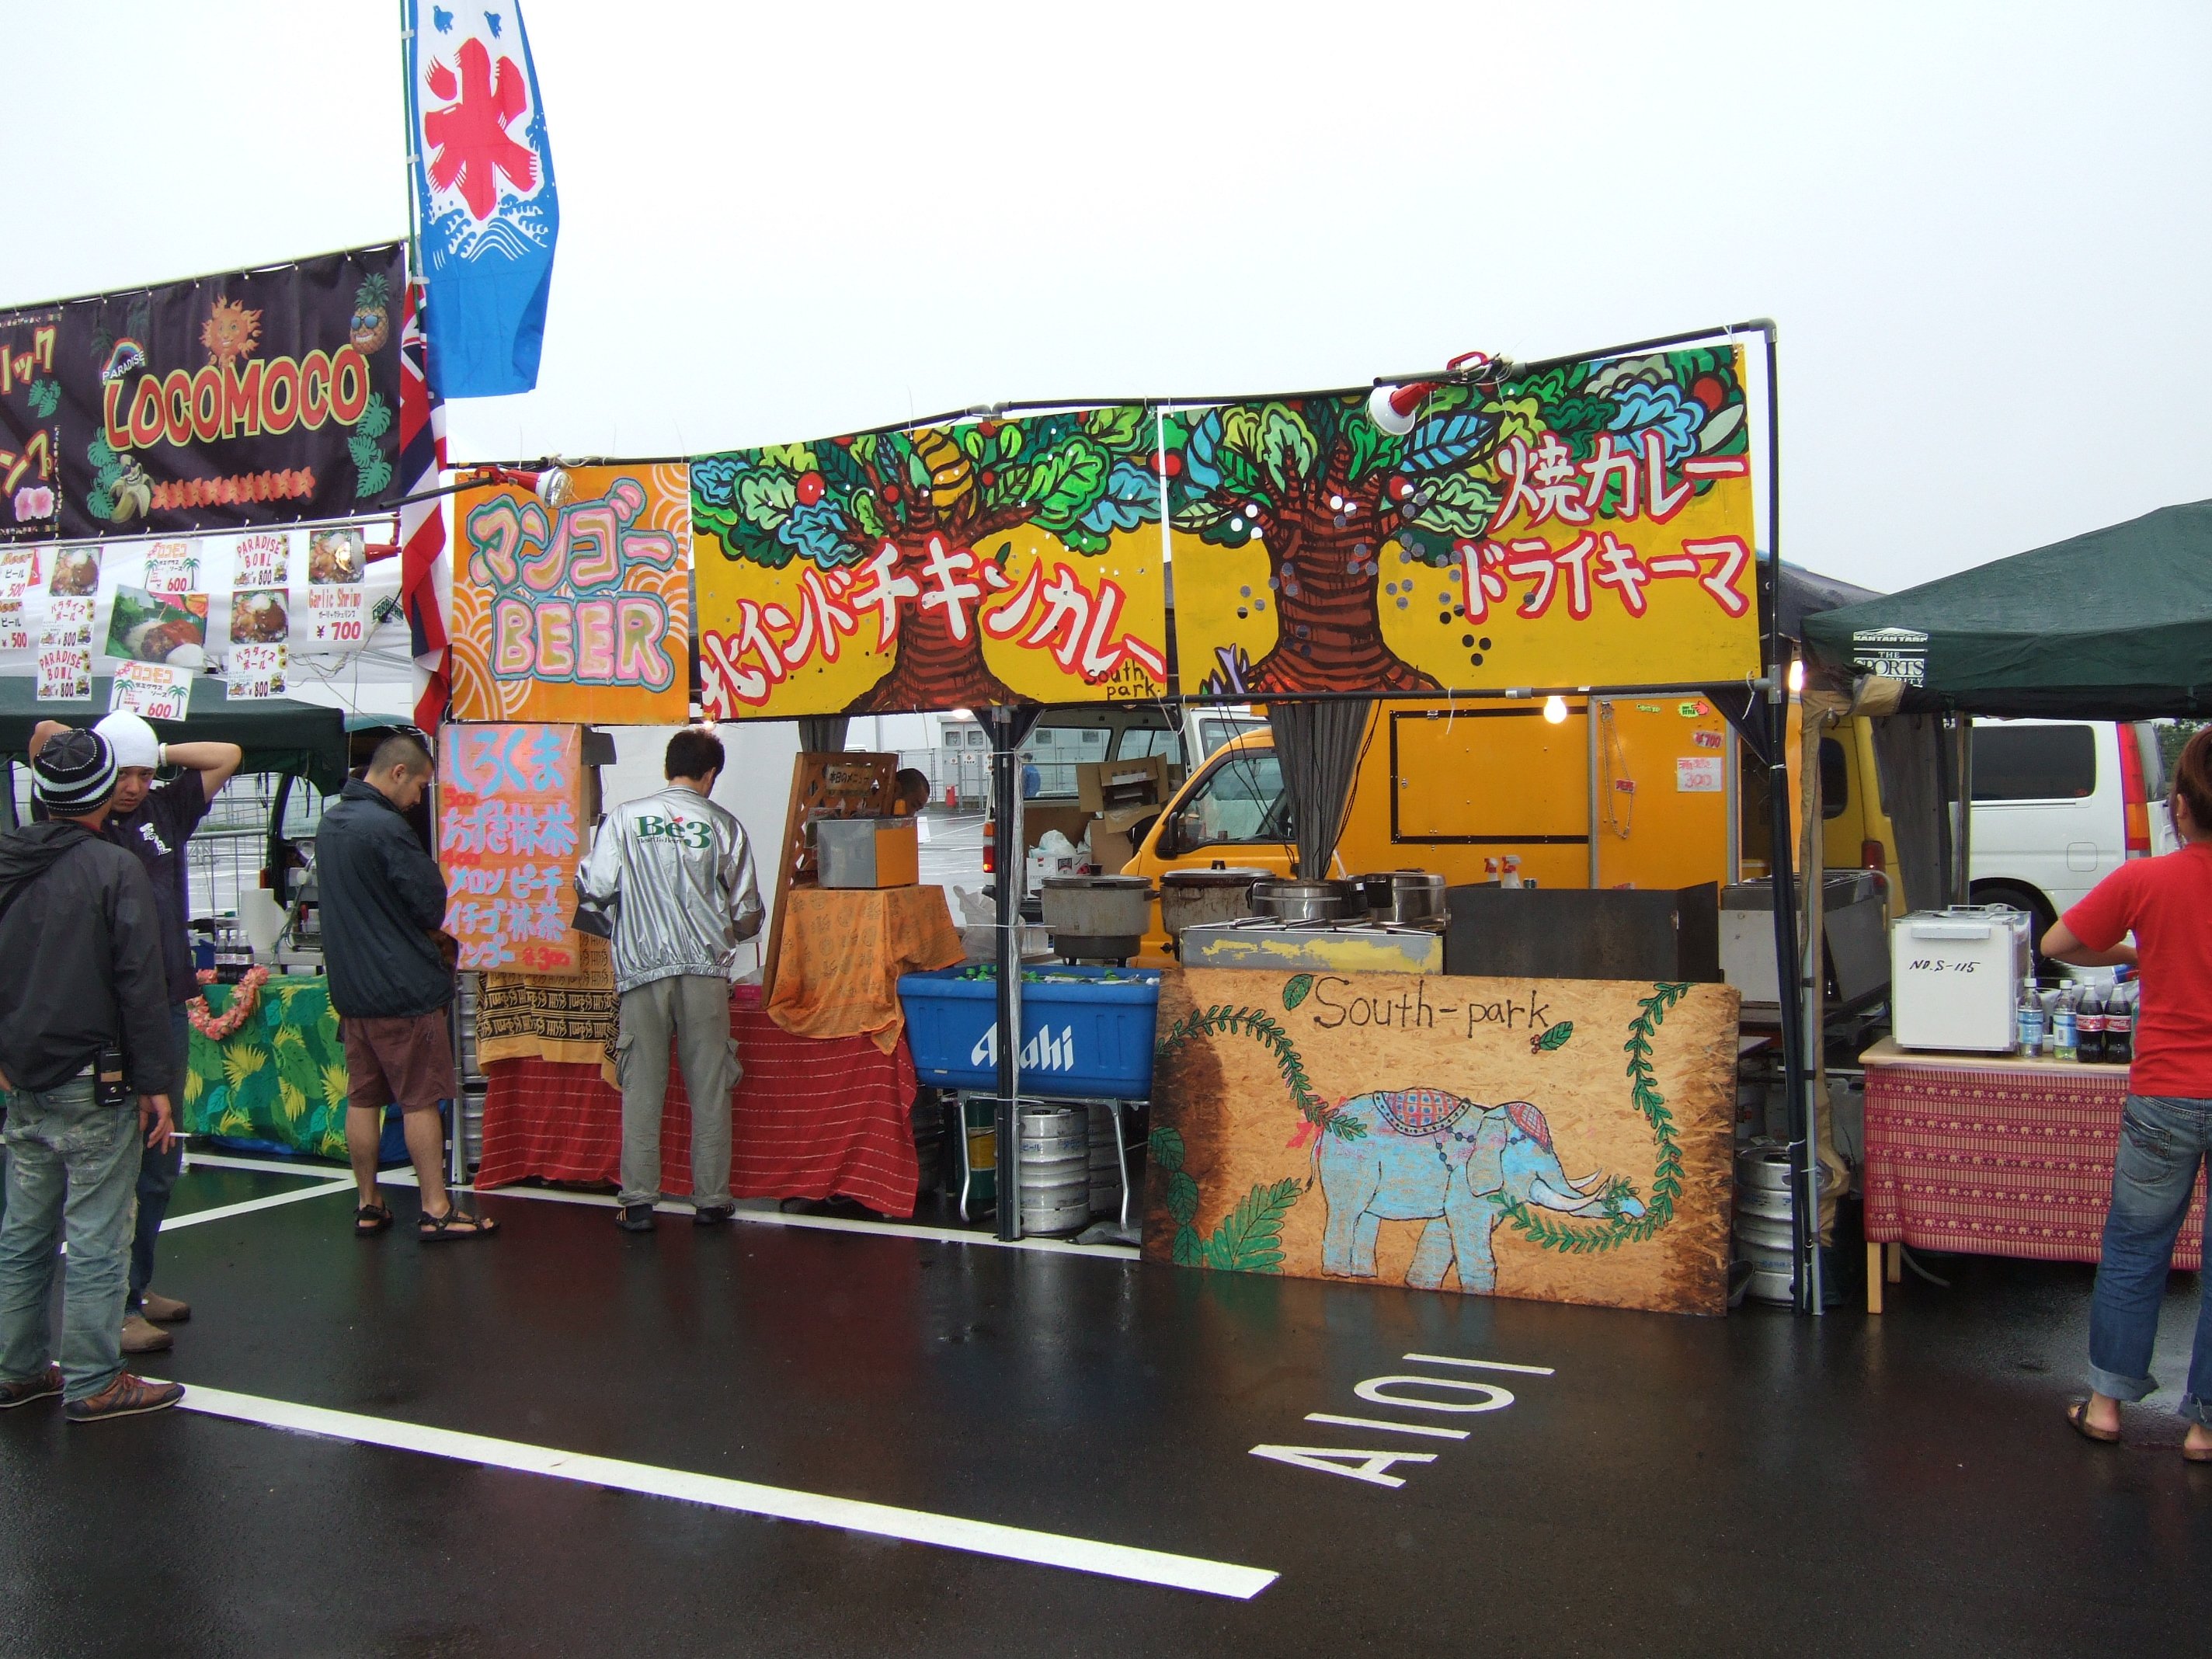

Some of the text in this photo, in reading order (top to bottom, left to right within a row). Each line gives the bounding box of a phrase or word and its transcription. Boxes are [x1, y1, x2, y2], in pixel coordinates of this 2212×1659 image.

[425, 37, 537, 221] 氷
[103, 350, 144, 382] PARADISE
[103, 344, 370, 452] LOCOMOCO
[1493, 431, 1748, 534] 焼カレー
[469, 479, 676, 592] マンゴー
[158, 543, 187, 558] ロコモコ
[237, 535, 281, 558] PARADISE
[245, 553, 271, 569] BOWL
[5, 569, 24, 578] ビール
[259, 569, 272, 586] 800
[1460, 532, 1750, 624] ドライキーマ
[167, 577, 187, 591] 600
[308, 587, 361, 609] Garlic Shrimp
[12, 632, 27, 648] 500
[63, 632, 77, 646] 800
[317, 621, 361, 640] ¥ 700
[489, 593, 674, 691] BEER
[40, 650, 82, 670] PARADISE
[236, 646, 276, 663] パラダイス
[47, 666, 72, 681] BOWL
[132, 666, 173, 683] ロコモコ
[1084, 659, 1144, 686] south
[61, 683, 74, 697] 800
[255, 681, 268, 697] 800
[148, 702, 172, 718] 600
[450, 725, 565, 798] しろくま
[443, 787, 476, 807] 500
[439, 850, 480, 867] 400
[447, 863, 565, 899] メロン ピーチ
[440, 898, 565, 942] イチゴ 抹茶
[972, 1022, 1074, 1072] Aahi
